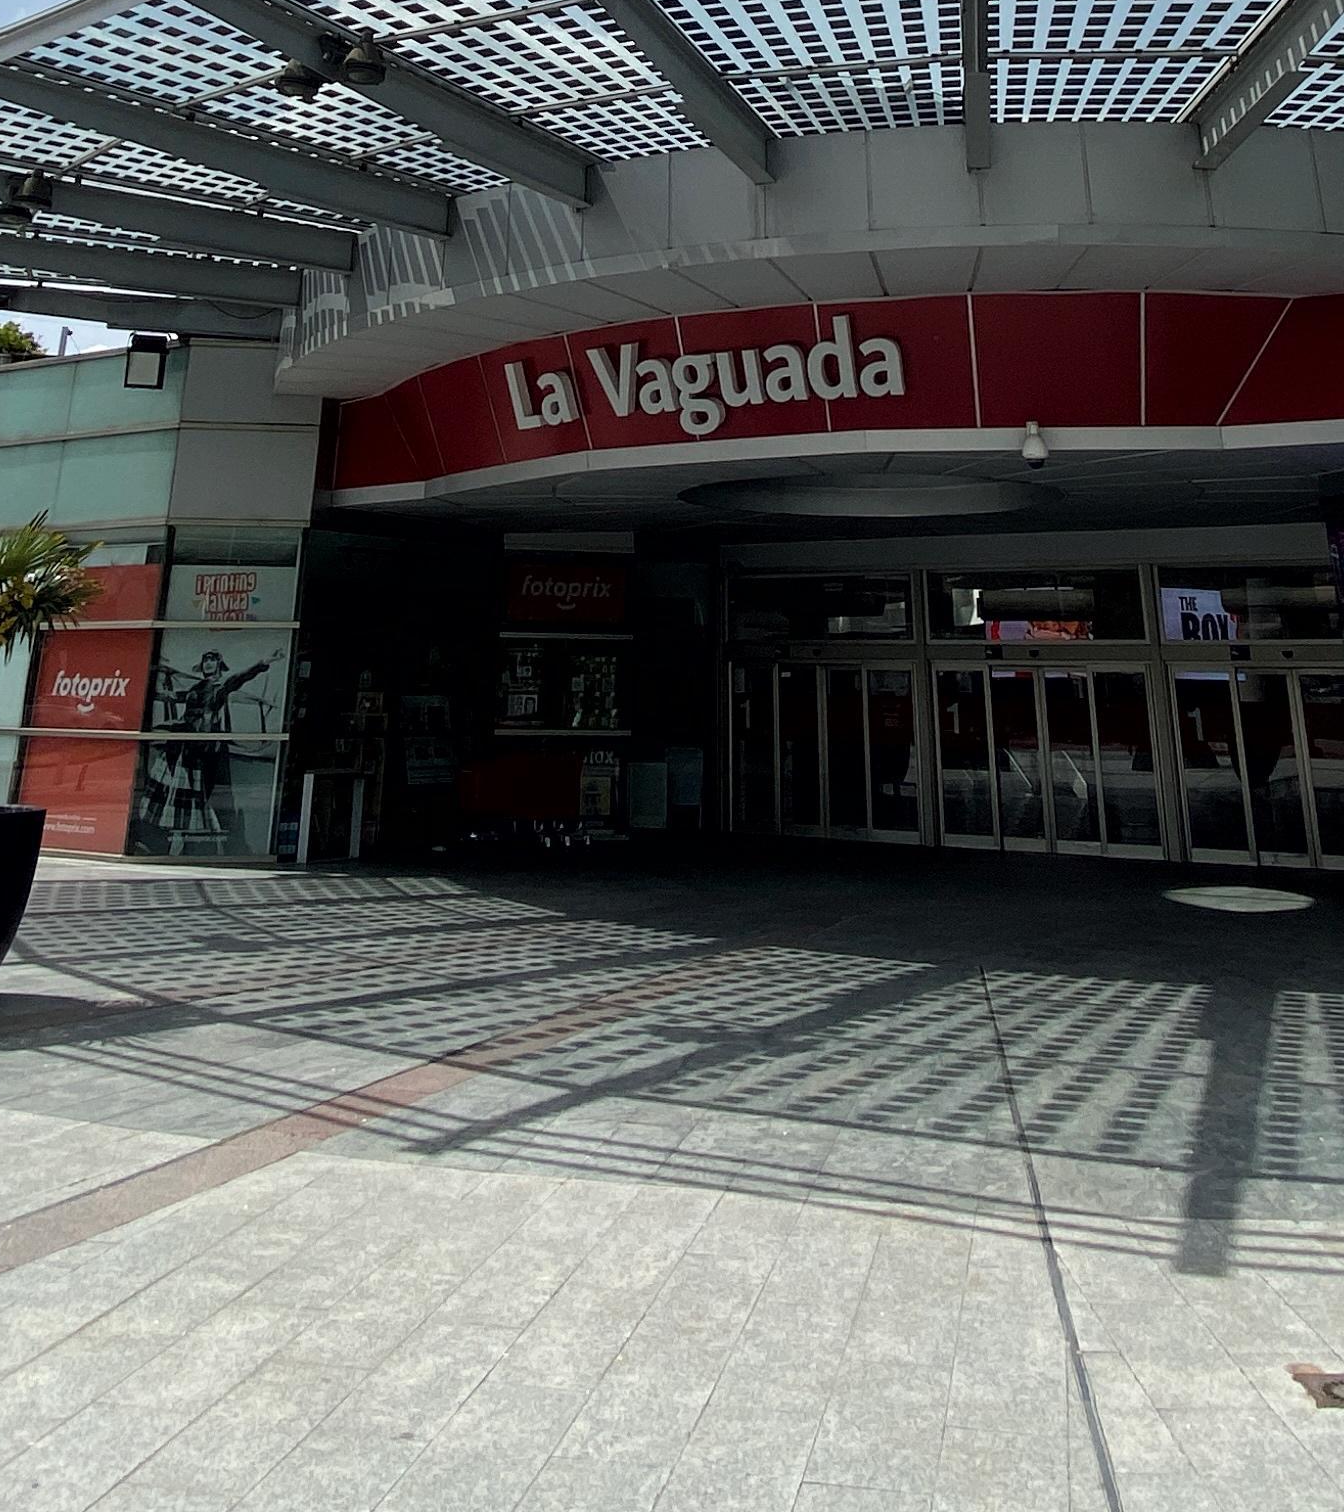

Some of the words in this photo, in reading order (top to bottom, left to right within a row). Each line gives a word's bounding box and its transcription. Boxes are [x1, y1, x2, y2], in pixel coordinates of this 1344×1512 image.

[504, 360, 580, 431] La
[585, 314, 906, 436] Vaguada
[520, 574, 613, 603] fotoprix
[1178, 597, 1198, 611] THE
[51, 669, 130, 702] fotoprix
[946, 702, 961, 735] 1
